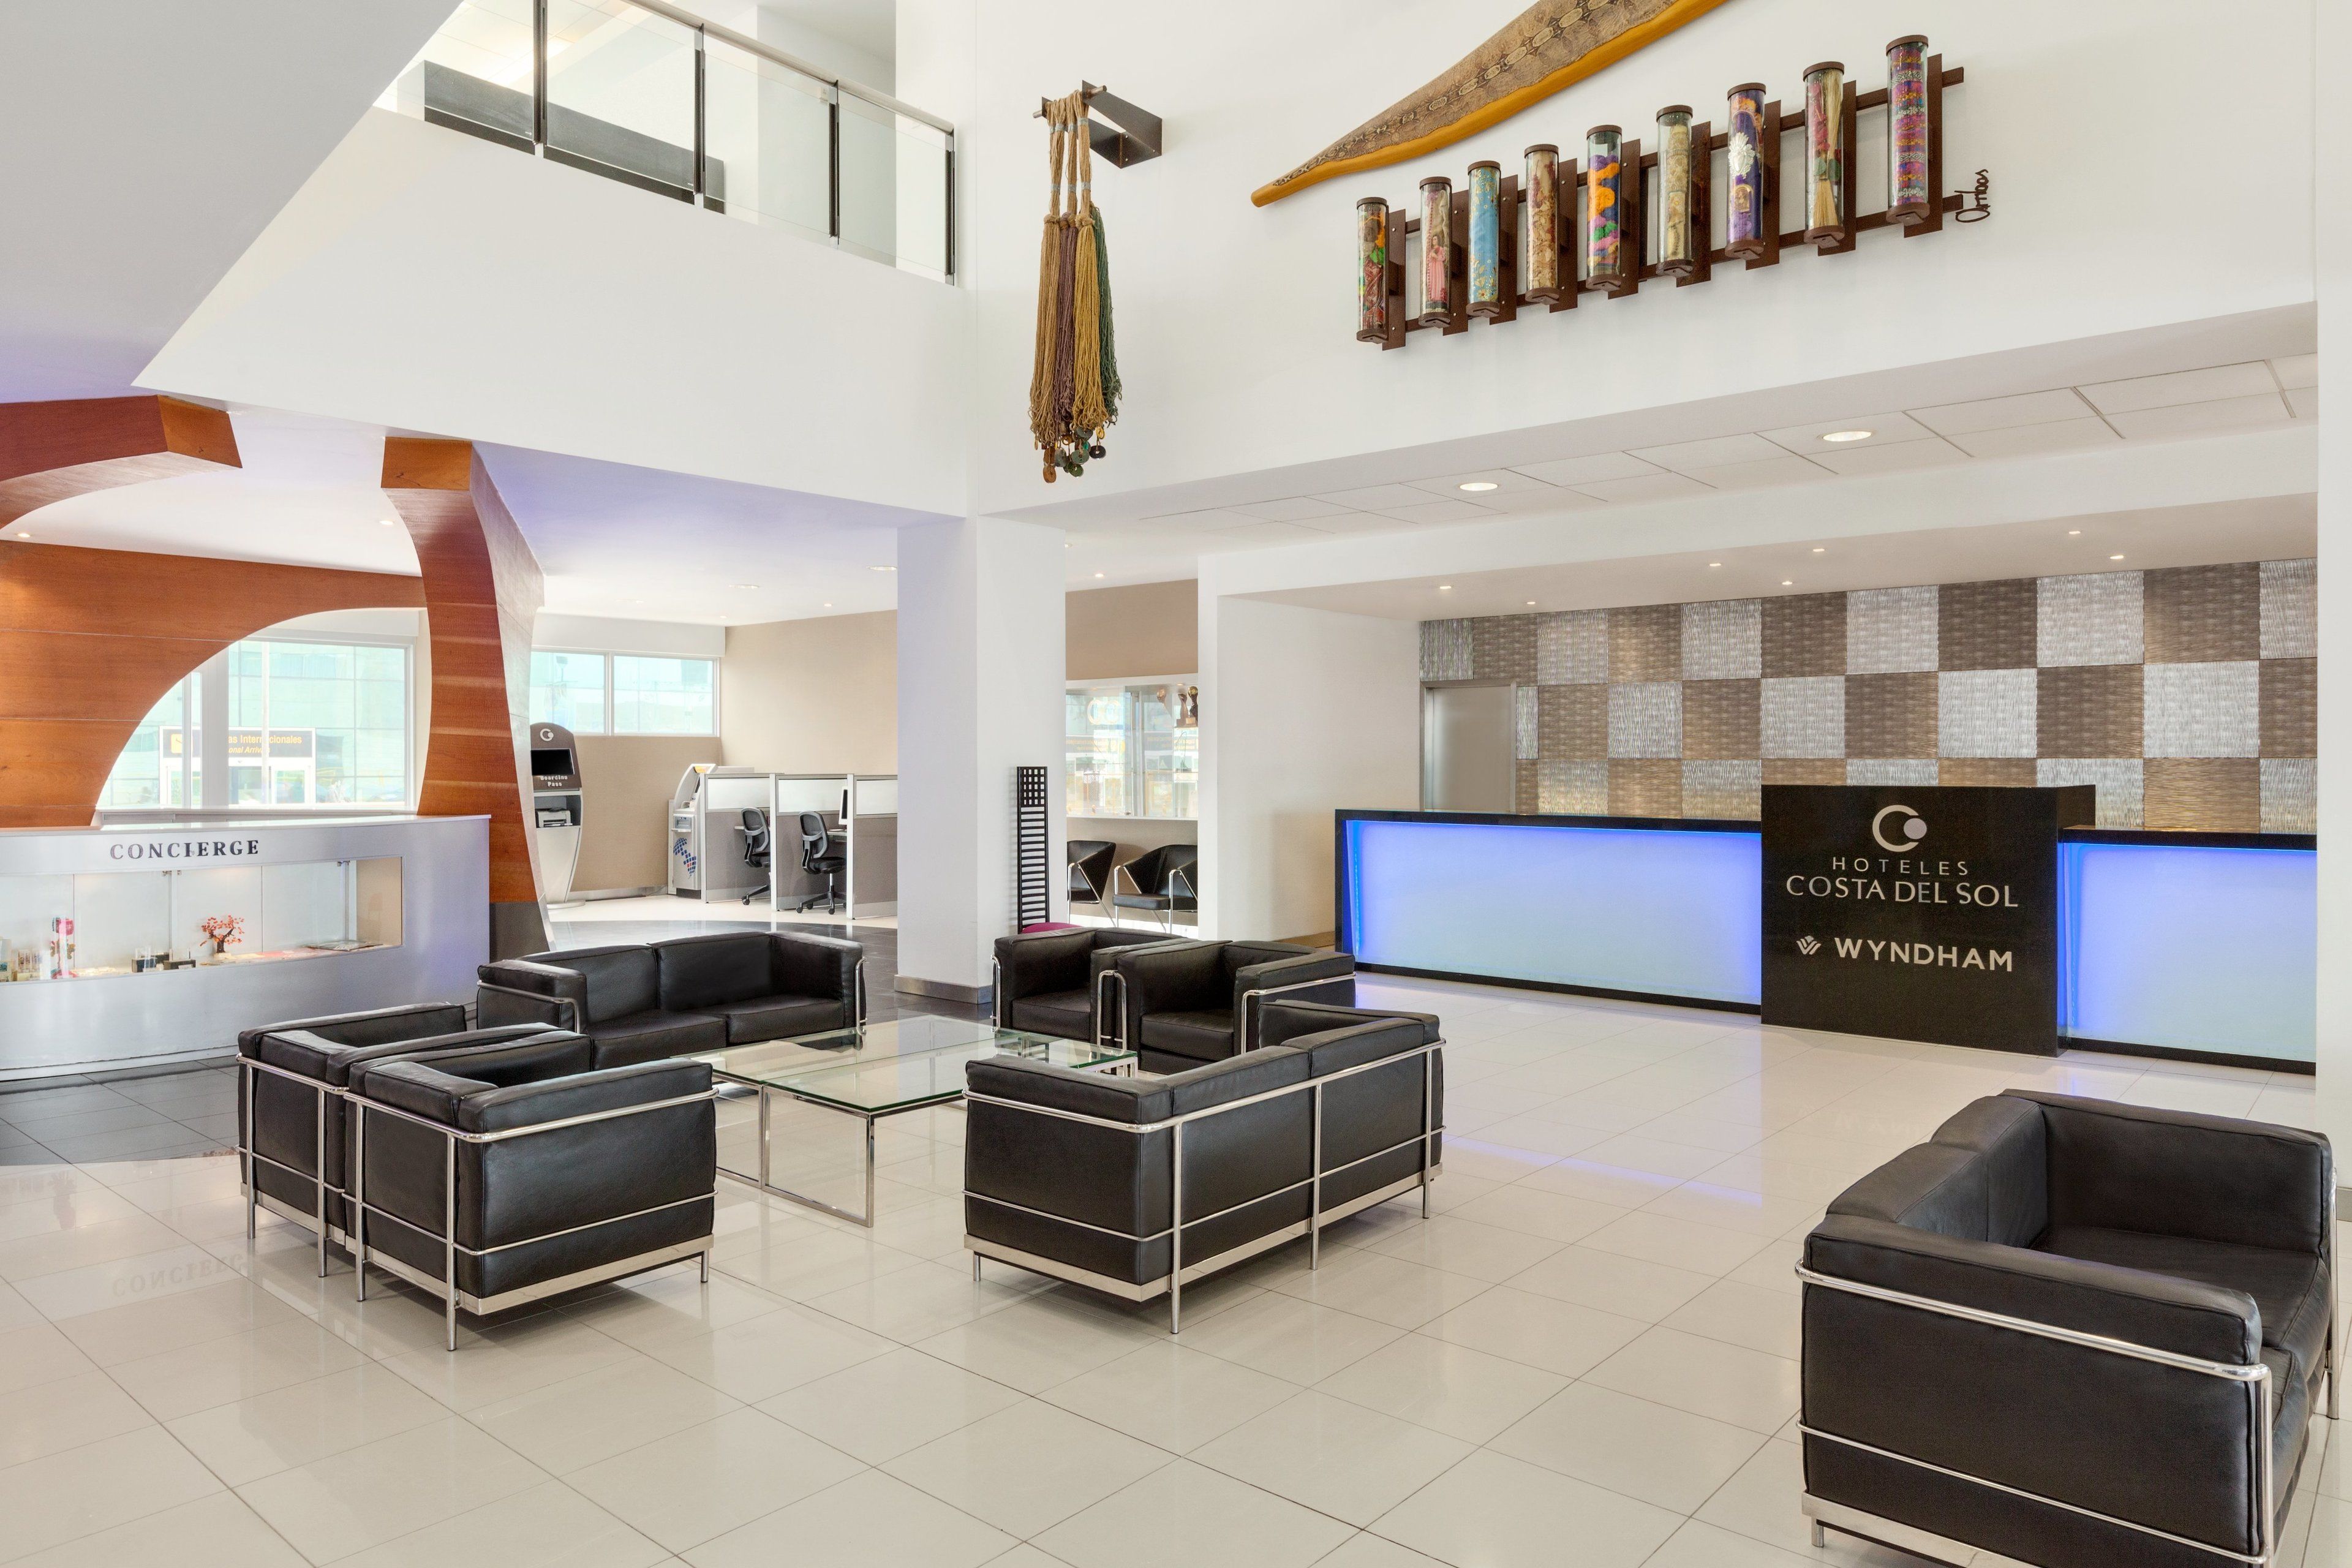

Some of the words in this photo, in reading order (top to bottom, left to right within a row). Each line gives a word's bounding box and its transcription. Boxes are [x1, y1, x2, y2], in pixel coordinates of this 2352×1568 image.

[240, 734, 302, 744] Intercionales
[110, 840, 259, 859] CONCIERGE
[1833, 857, 1968, 876] HOTELES
[1786, 875, 1886, 900] COSTA
[1895, 881, 1948, 903] DEL
[1956, 882, 2018, 907] SOL
[1834, 937, 2013, 972] WYNDHAM
